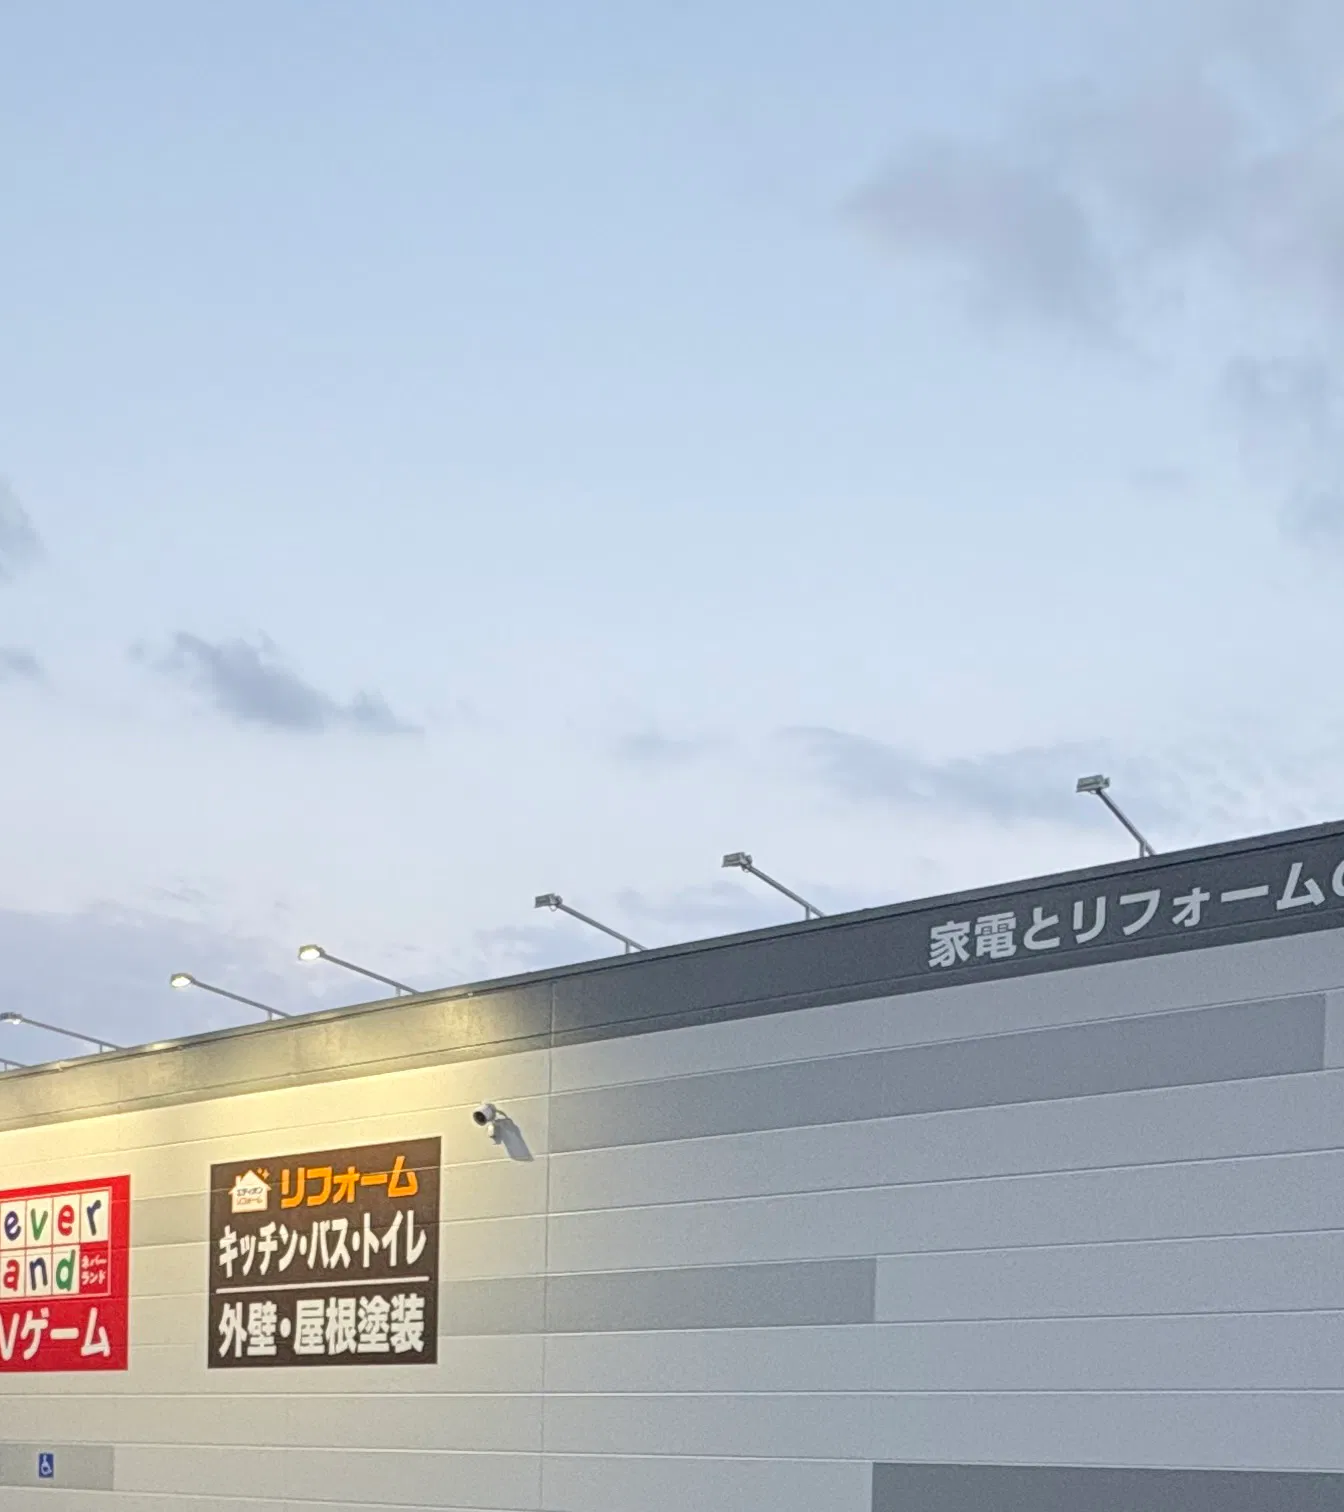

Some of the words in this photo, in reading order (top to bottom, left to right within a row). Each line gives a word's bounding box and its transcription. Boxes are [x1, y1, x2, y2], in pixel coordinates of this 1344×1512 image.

[280, 1156, 418, 1209] リフォーム
[219, 1210, 427, 1278] キッチン・バス・トイレ
[81, 1271, 106, 1285] ランド
[219, 1293, 425, 1358] 外壁・屋根塗装
